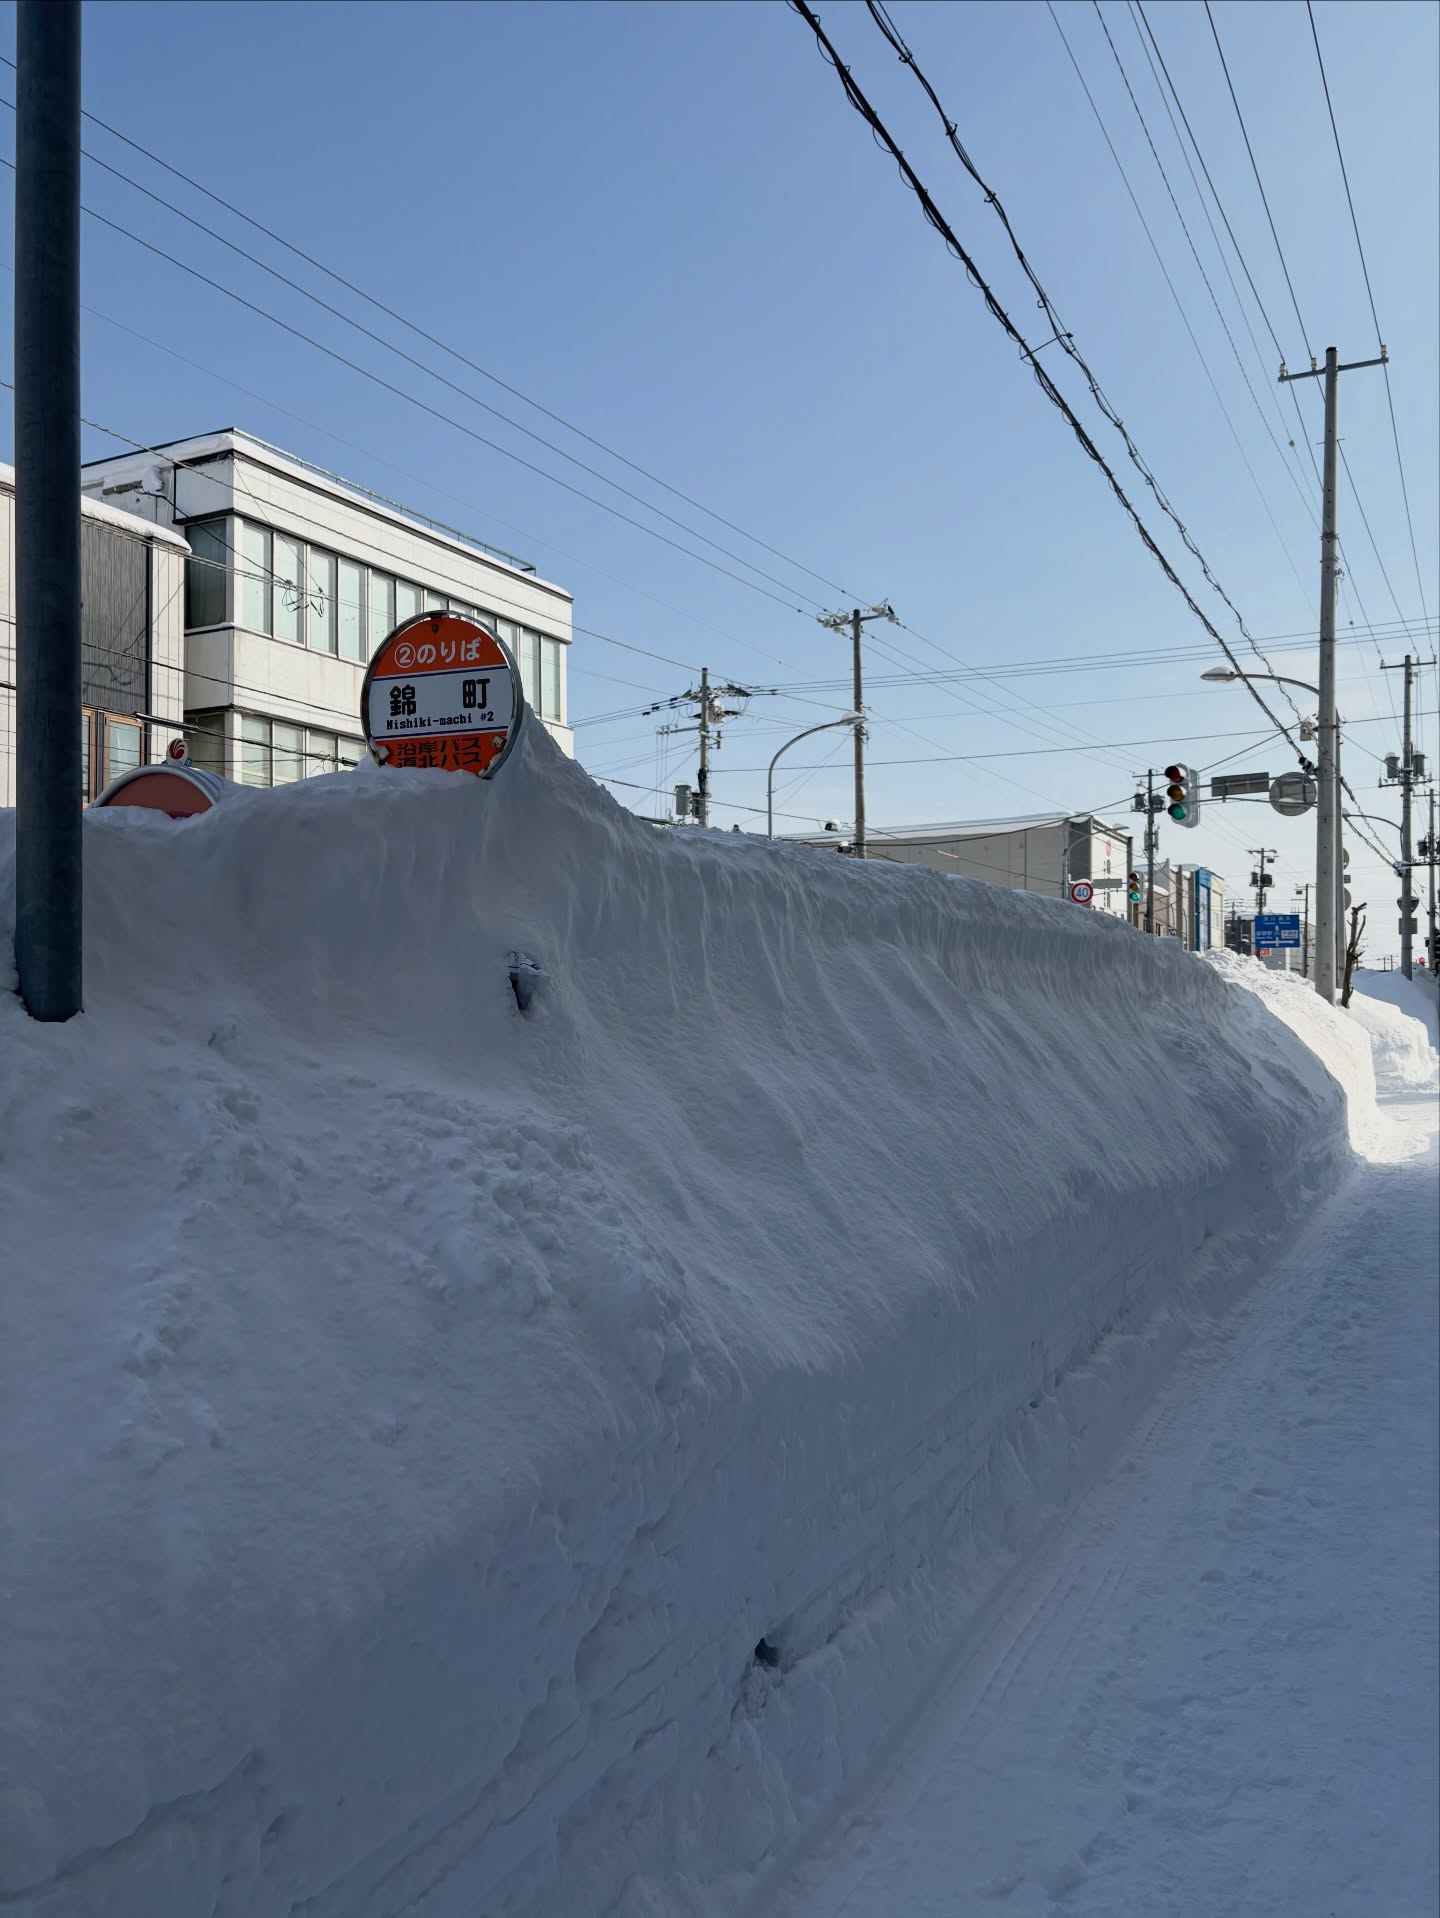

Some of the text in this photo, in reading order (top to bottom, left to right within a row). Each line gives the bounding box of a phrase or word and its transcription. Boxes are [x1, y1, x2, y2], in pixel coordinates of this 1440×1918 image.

[387, 711, 494, 730] Nishiki-machi #2
[397, 737, 480, 756] 沿岸バス
[1076, 887, 1089, 898] 40
